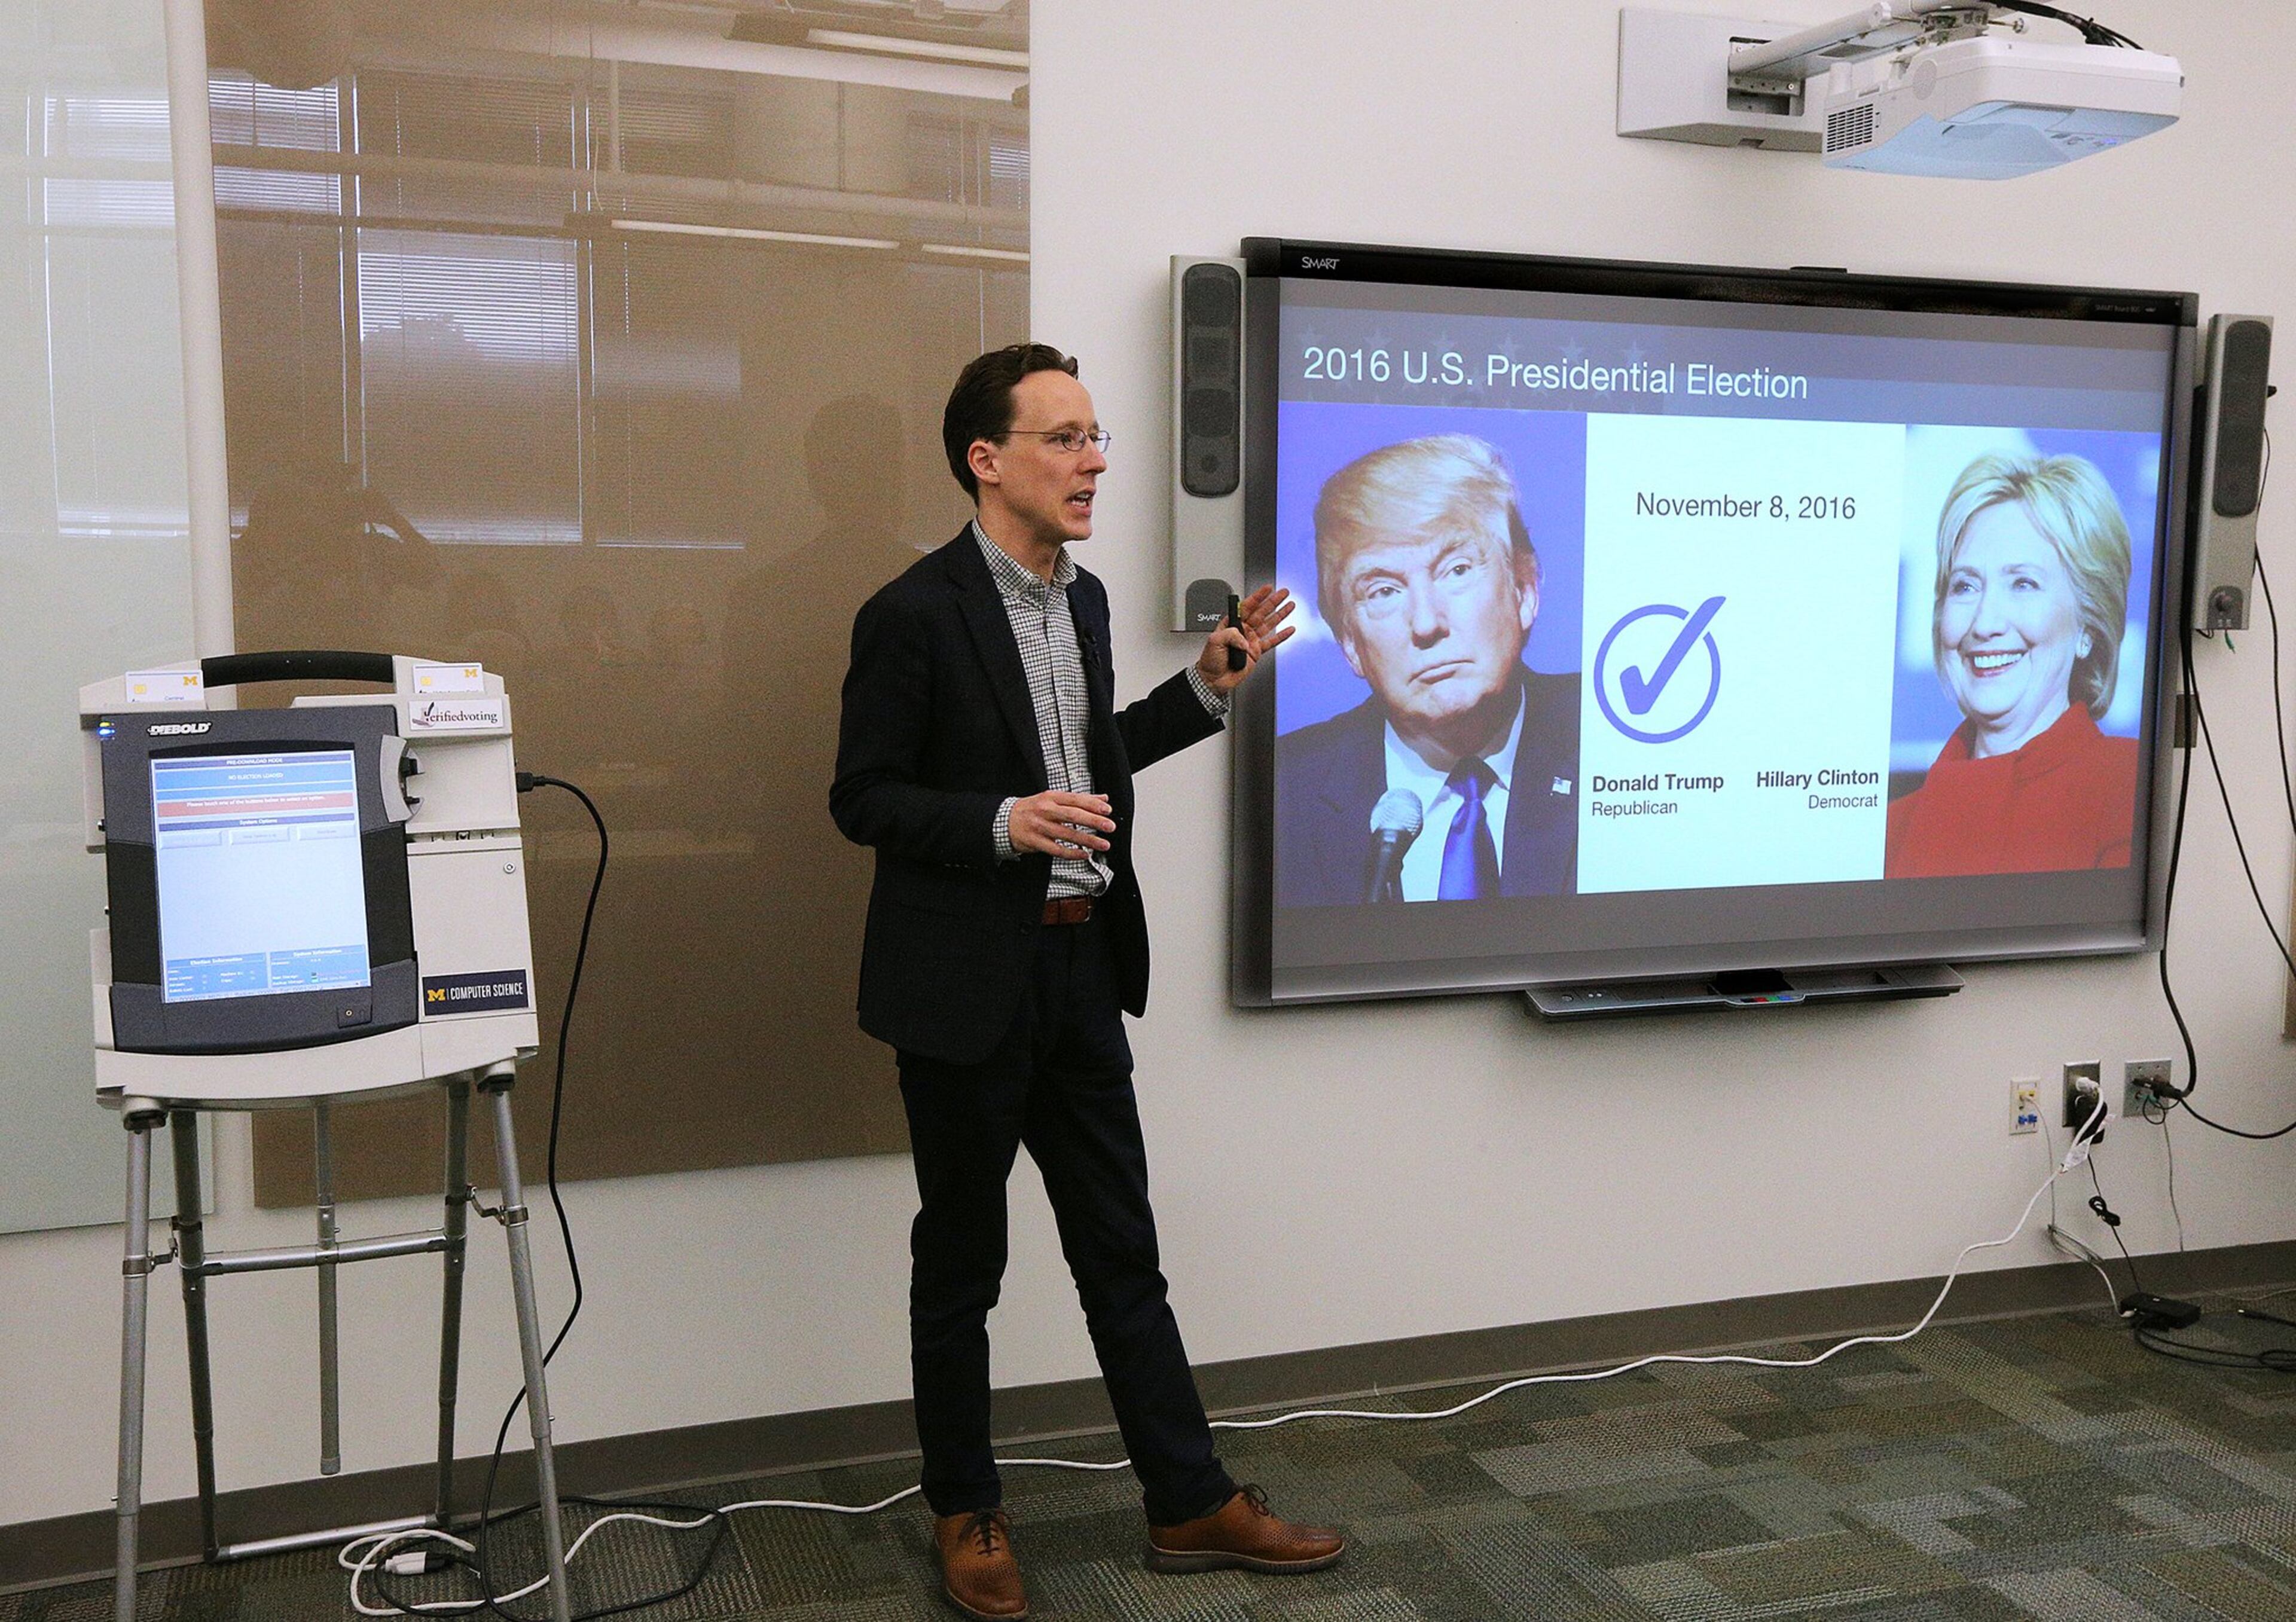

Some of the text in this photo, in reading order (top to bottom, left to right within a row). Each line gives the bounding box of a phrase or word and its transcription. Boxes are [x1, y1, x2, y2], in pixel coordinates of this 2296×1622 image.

[1302, 256, 1340, 270] SMART
[1303, 347, 1808, 399] 2016 U.S. Presidential Election
[1636, 492, 1856, 521] November 8, 2016
[183, 676, 198, 686] M
[464, 668, 478, 678] M
[146, 722, 212, 736] DIEBOLD
[1592, 774, 1724, 793] Donald Trump
[1756, 769, 1879, 790] Hillary Clinton
[1592, 801, 1678, 819] Republican
[1808, 794, 1877, 809] Democrat
[427, 982, 523, 1001] M COMPUTER SCIENCE
